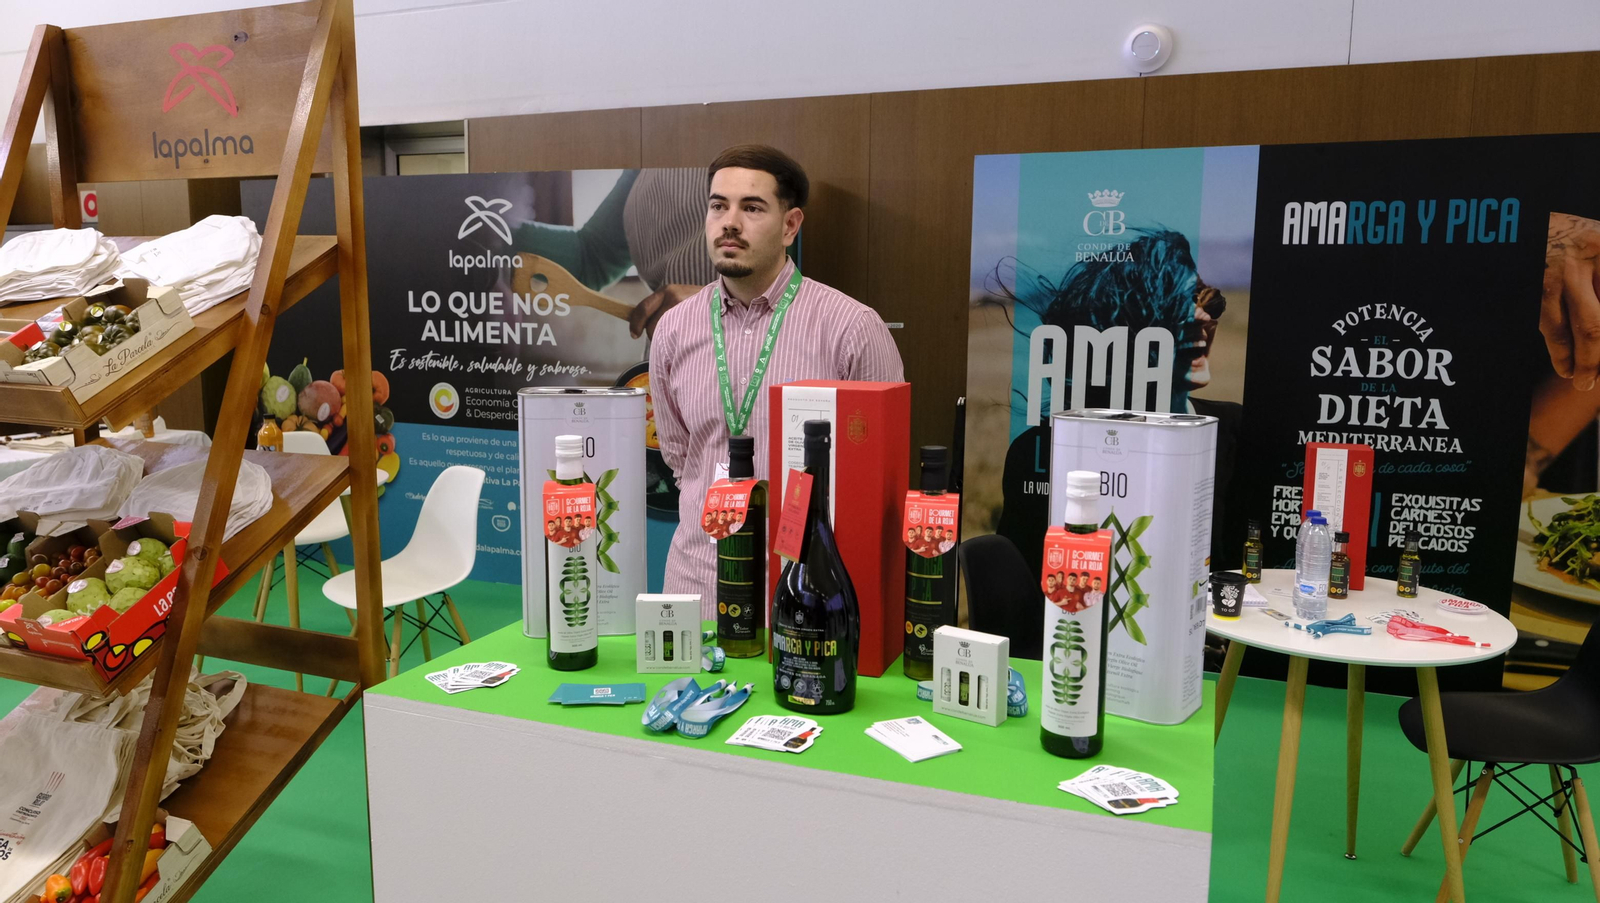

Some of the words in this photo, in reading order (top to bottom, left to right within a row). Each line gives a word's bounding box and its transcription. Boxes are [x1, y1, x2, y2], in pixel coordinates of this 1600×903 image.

[152, 128, 254, 169] lapalma
[1282, 200, 1406, 245] AMARGA
[1417, 199, 1437, 244] Y
[1445, 198, 1521, 243] PICA
[1077, 243, 1113, 251] CONDE
[1117, 243, 1131, 251] DE
[449, 249, 523, 275] lapalma
[1075, 249, 1134, 262] BENALÚA
[408, 290, 441, 313] LO
[448, 291, 504, 318] QUE
[512, 293, 571, 316] NOS
[1331, 303, 1434, 343] POTENCIA
[420, 319, 557, 346] ALIMENTA
[1374, 335, 1388, 345] EL
[389, 348, 407, 371] Es
[408, 349, 464, 371] sostenible,
[467, 356, 523, 374] saludable
[526, 363, 538, 381] y
[539, 360, 593, 377] sabroso.
[1310, 345, 1456, 386] SABOR
[1026, 324, 1175, 426] AMA
[465, 387, 512, 396] AGRICULTURA
[1360, 383, 1376, 392] DE
[1381, 383, 1397, 392] LA
[465, 396, 510, 408] Economía
[465, 408, 472, 417] &
[1316, 393, 1450, 429] DIETA
[422, 432, 431, 440] Es
[432, 433, 439, 441] lo
[456, 436, 489, 446] proviene
[490, 438, 501, 446] de
[446, 448, 487, 459] respetuosa
[496, 451, 505, 460] de
[1035, 435, 1046, 473] L
[409, 457, 418, 466] Es
[418, 458, 446, 468] aquello
[496, 465, 504, 473] el
[501, 478, 511, 486] La
[1024, 480, 1034, 494] LA
[1100, 471, 1128, 498] BIO
[1273, 485, 1304, 499] FRE
[566, 505, 574, 513] DE
[574, 505, 580, 513] LA
[1272, 498, 1303, 512] HOR
[1391, 492, 1482, 512] EXQUISITAS
[1390, 507, 1453, 523] CARNES
[1454, 511, 1465, 524] Y
[1270, 525, 1280, 538] Y
[1388, 534, 1470, 553] PECADOS
[1072, 549, 1105, 562] GOURMET
[1071, 559, 1079, 570] DE
[1080, 560, 1088, 570] LA
[1088, 561, 1103, 571] ROJA
[660, 609, 675, 618] CB
[804, 640, 812, 656] Y
[814, 639, 838, 657] PICA
[957, 647, 972, 658] CB
